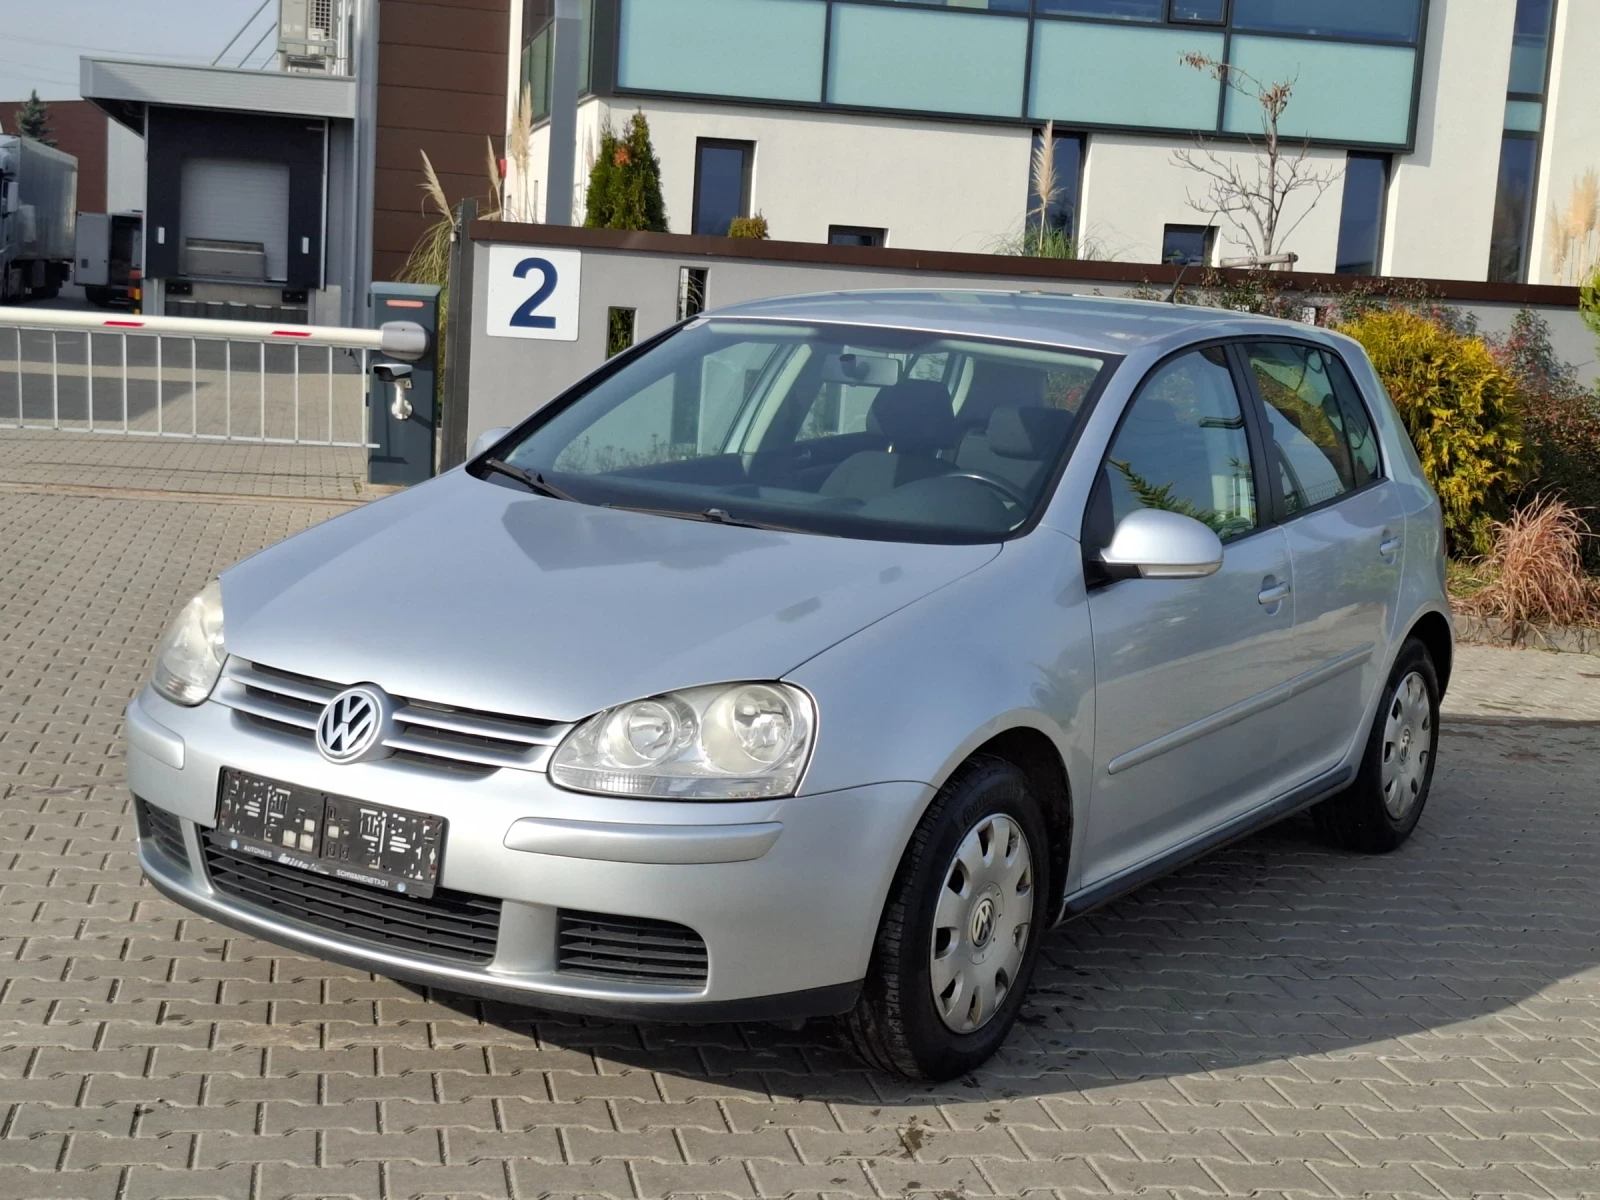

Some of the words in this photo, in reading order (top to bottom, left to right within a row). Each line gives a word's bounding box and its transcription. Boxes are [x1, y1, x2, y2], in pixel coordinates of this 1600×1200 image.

[509, 257, 558, 329] 2
[318, 689, 381, 761] VW
[243, 845, 273, 858] AUTOHAUS
